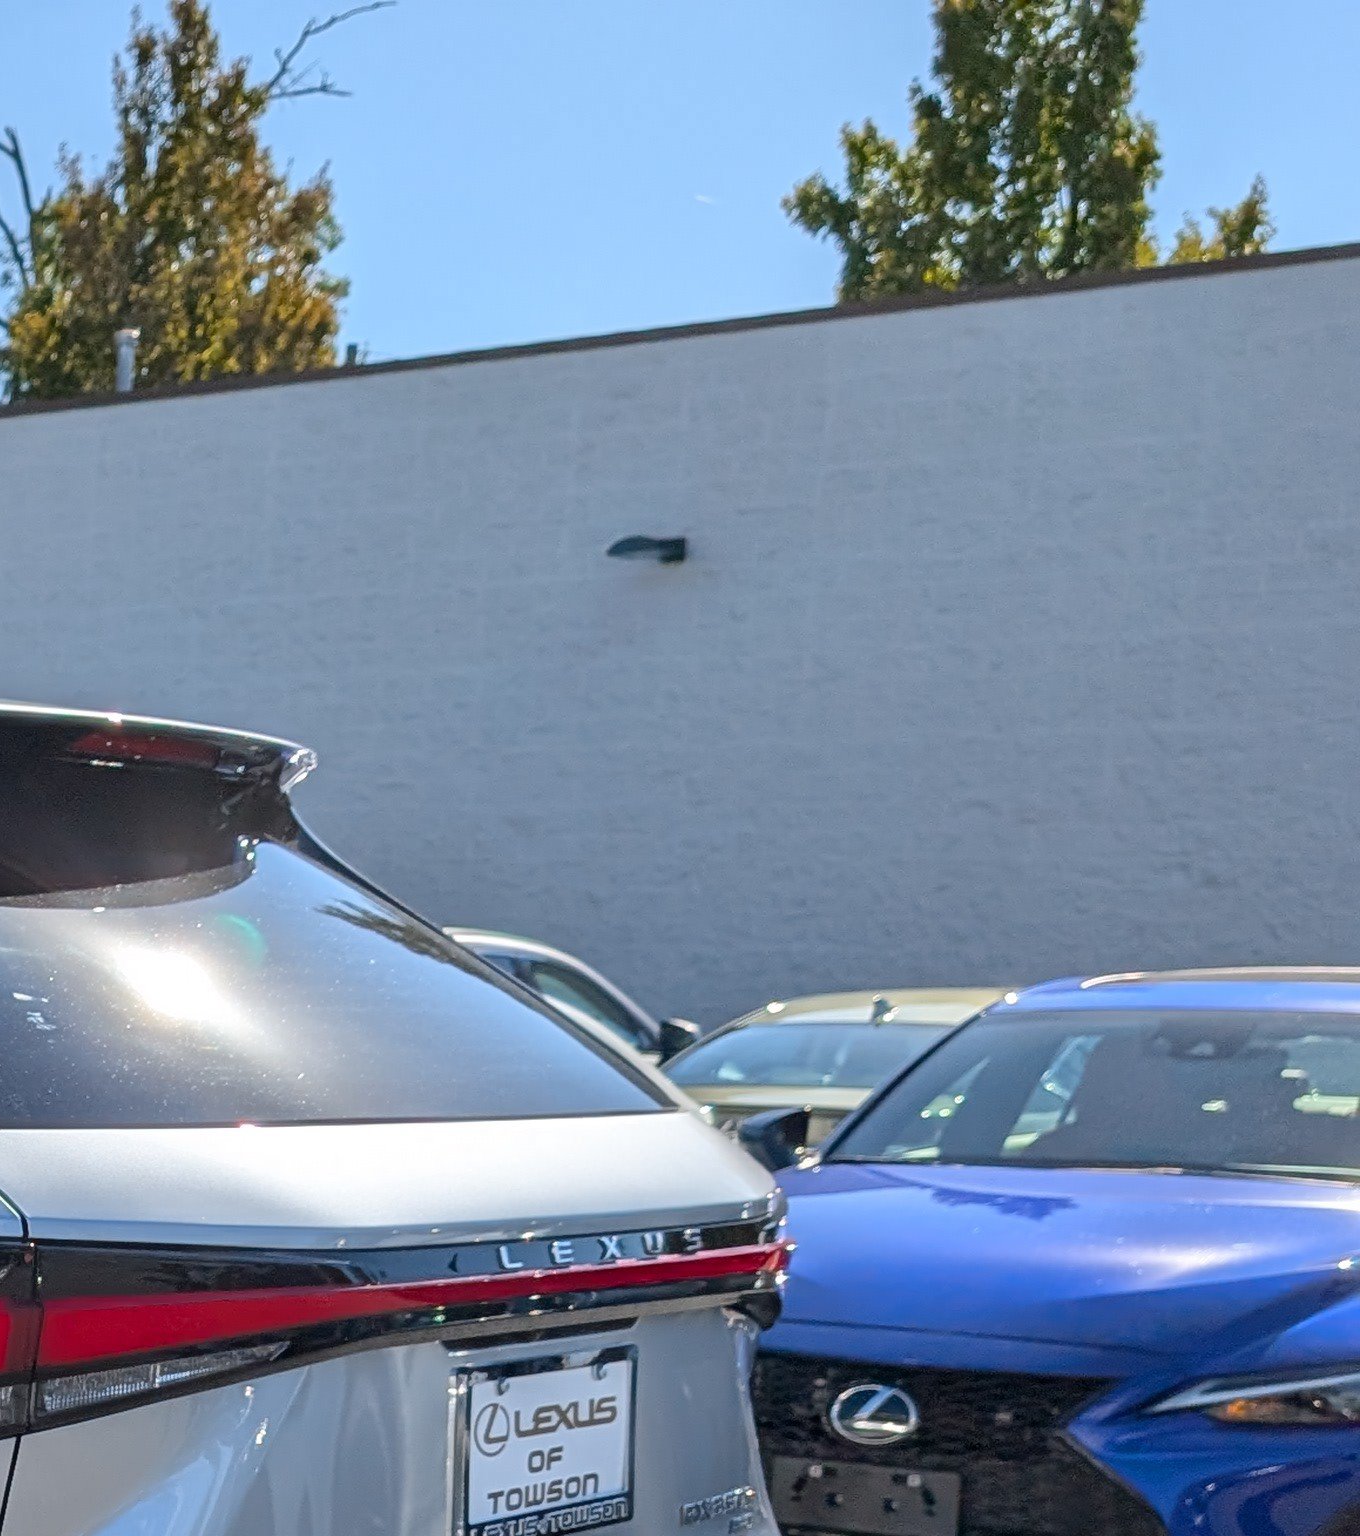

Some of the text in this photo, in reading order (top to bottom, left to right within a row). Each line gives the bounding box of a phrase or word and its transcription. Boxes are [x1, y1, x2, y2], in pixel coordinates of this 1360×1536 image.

[499, 1228, 702, 1269] LEXUS
[514, 1396, 617, 1438] LEXUS
[528, 1446, 563, 1473] OF
[487, 1472, 599, 1514] TOWSON
[546, 1498, 627, 1533] TOWSON
